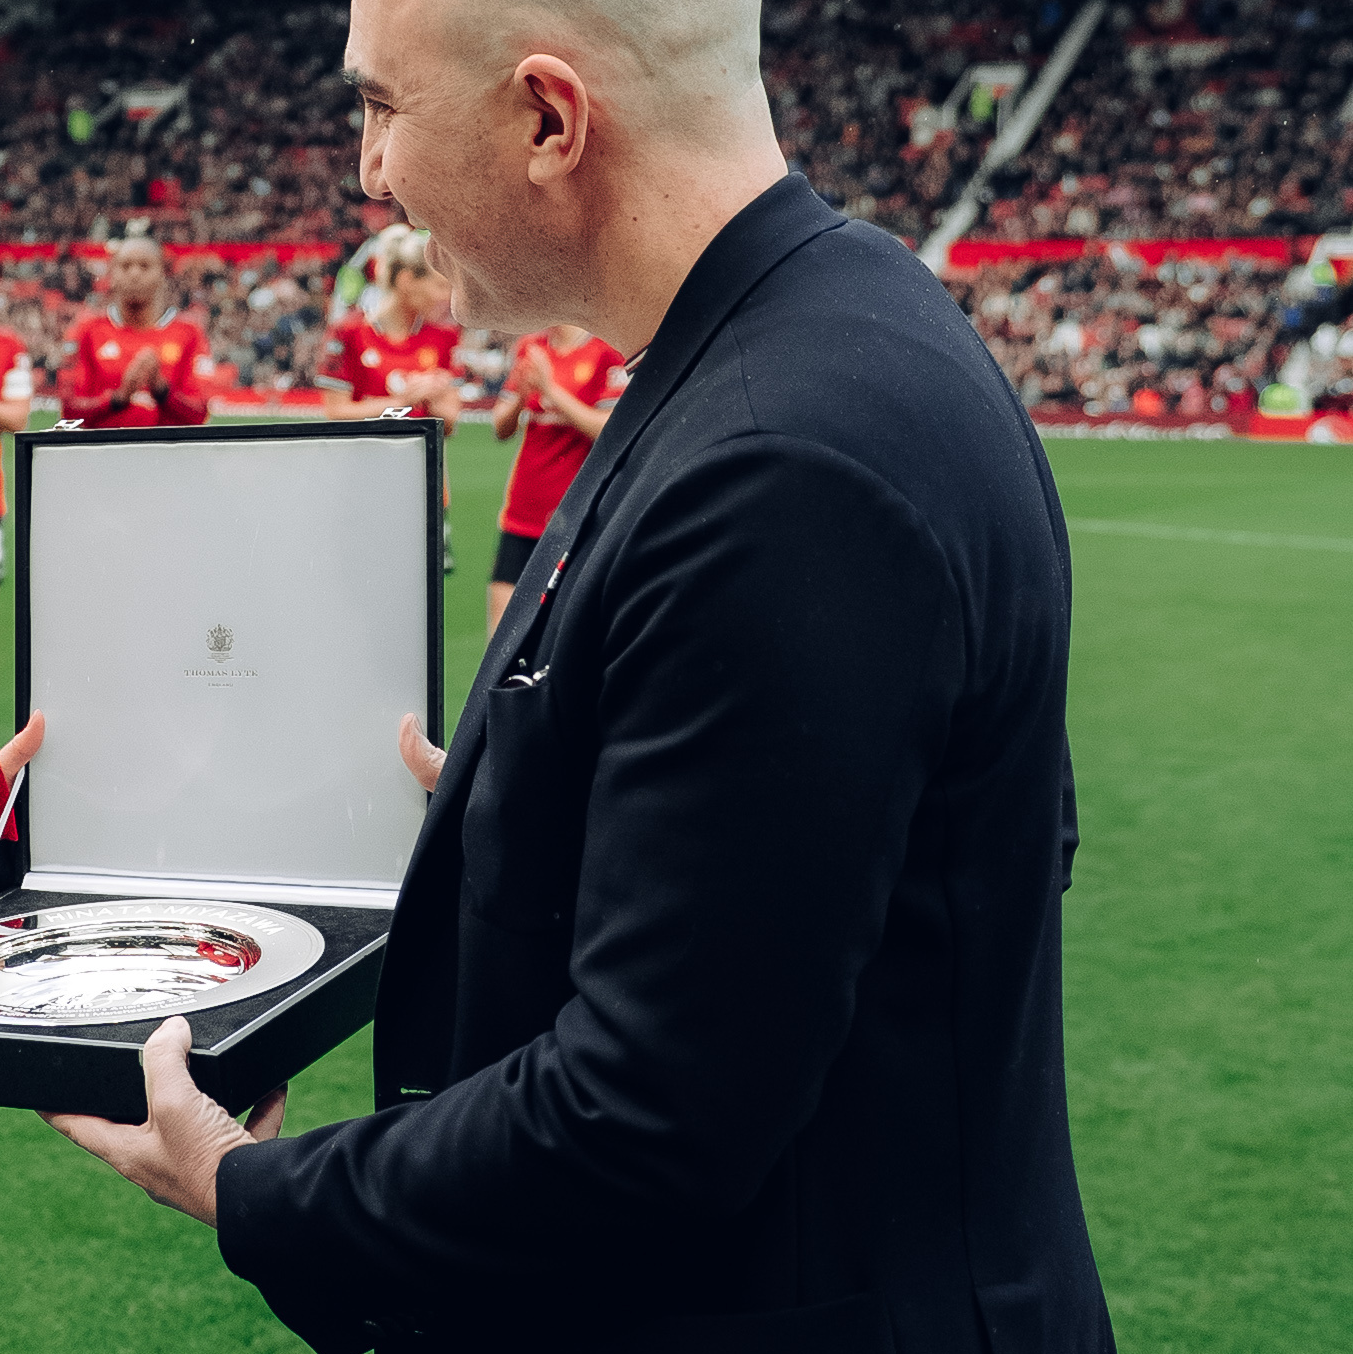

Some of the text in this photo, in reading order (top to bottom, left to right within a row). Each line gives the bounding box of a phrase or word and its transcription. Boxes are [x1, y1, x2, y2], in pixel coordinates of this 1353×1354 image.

[184, 669, 228, 677] THOMAS
[45, 904, 285, 936] HINATA MIYAZAWA
